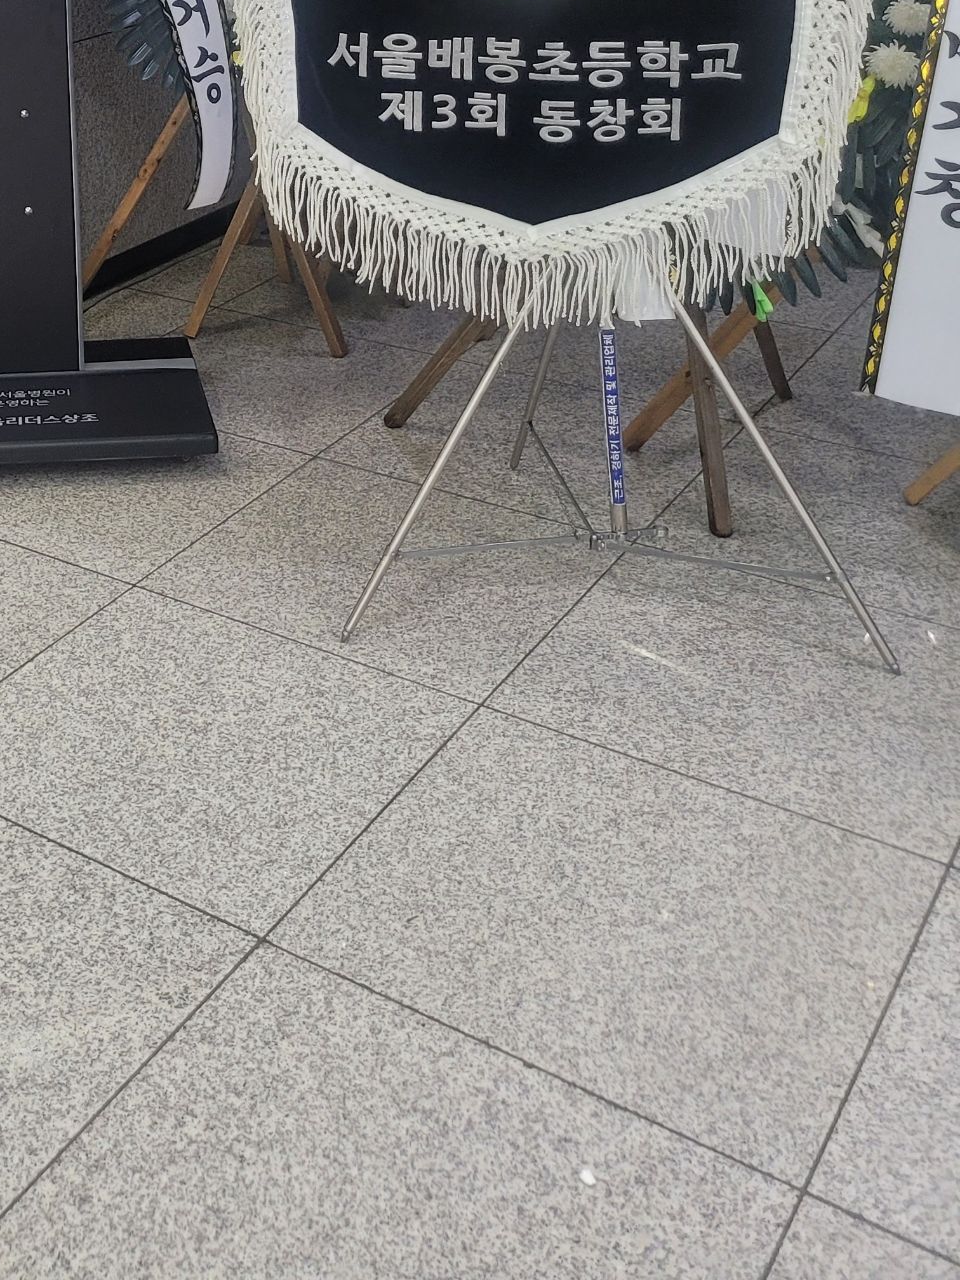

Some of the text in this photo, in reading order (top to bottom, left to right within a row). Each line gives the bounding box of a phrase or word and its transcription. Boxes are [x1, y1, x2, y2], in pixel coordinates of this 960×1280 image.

[327, 32, 743, 88] 서울배봉초등학교
[378, 91, 682, 143] 제3회 동창회
[606, 394, 620, 436] 전문제작
